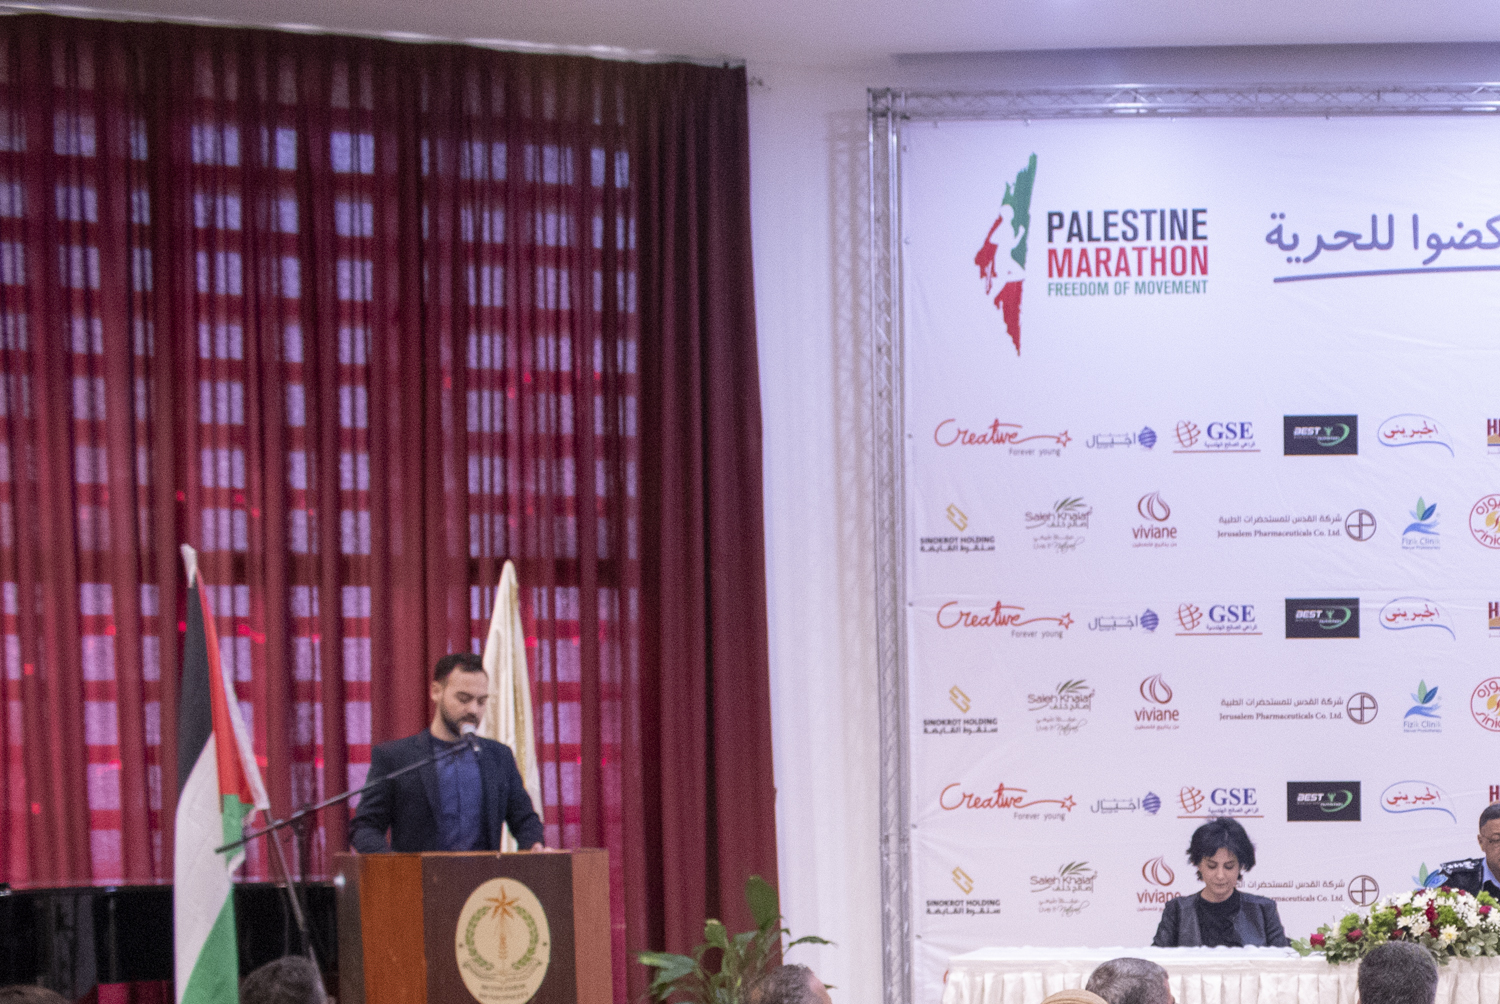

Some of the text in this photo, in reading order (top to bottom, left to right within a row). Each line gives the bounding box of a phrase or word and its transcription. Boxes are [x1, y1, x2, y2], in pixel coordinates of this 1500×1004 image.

[1048, 208, 1208, 242] PALESTINE
[1265, 212, 1395, 264] للحرية
[1048, 245, 1208, 278] MARATHON
[1048, 280, 1208, 296] FREEDOM OF MOVEMENT
[934, 418, 1025, 447] Creative
[1207, 422, 1253, 439] GSE
[1293, 426, 1322, 436] BEST
[1132, 525, 1177, 539] viviane
[1216, 529, 1342, 539] Jerusalem Pharmaceuticals Co. Ltd.
[936, 600, 1028, 629] Creative
[1209, 605, 1255, 622] GSE
[1295, 609, 1323, 619] BEST
[1134, 707, 1179, 721] viviane
[1218, 712, 1344, 722] Jerusalem Pharmaceuticals Co. Ltd.
[939, 782, 1030, 811] Creative
[1210, 788, 1256, 805] GSE
[1296, 792, 1325, 802] BEST
